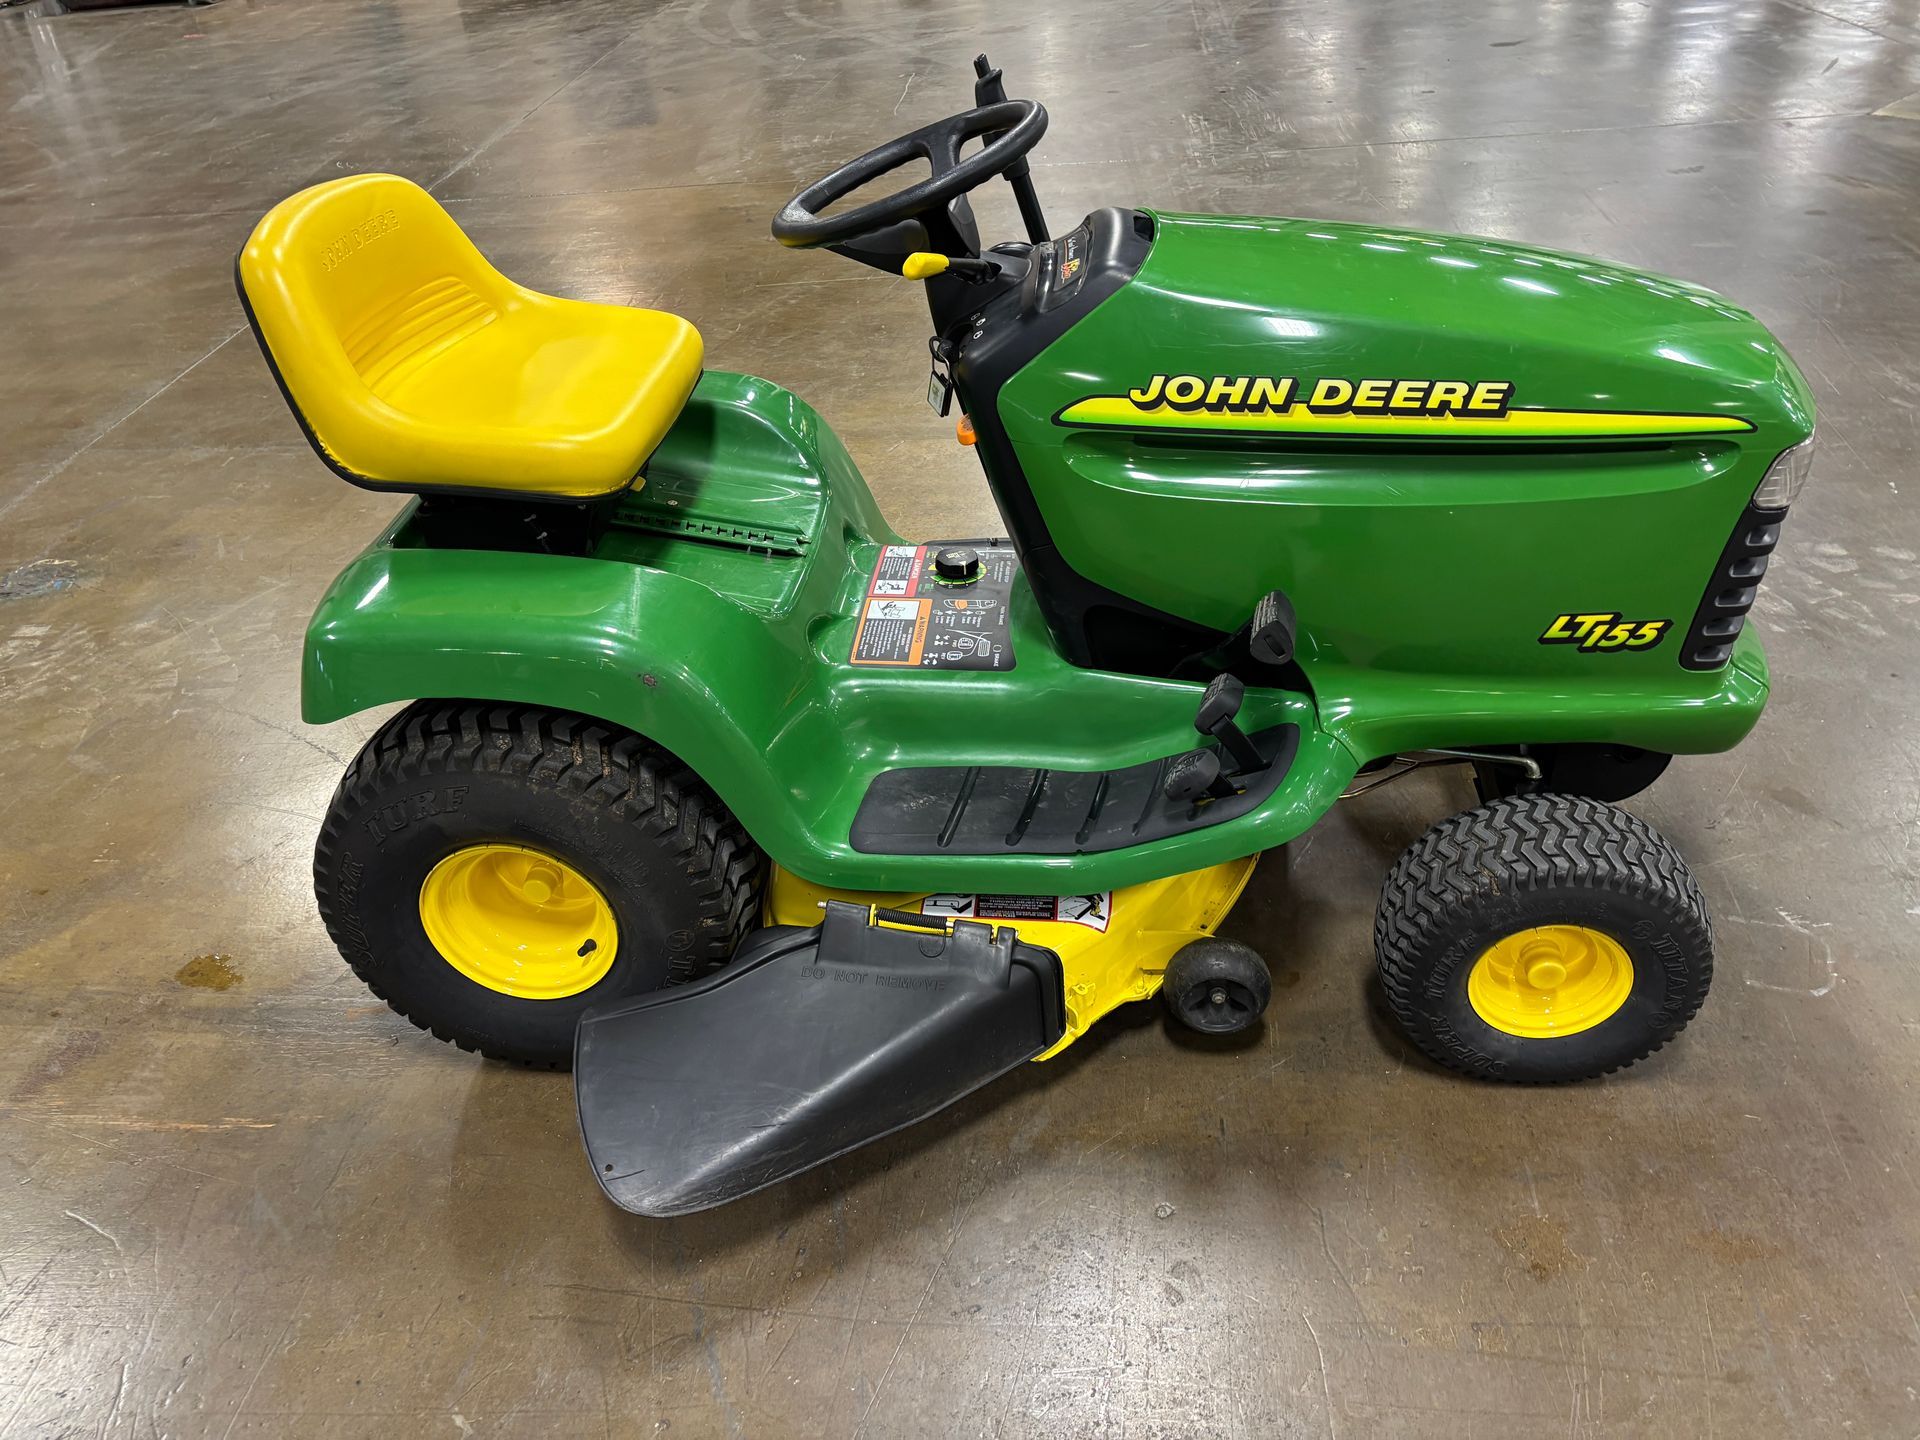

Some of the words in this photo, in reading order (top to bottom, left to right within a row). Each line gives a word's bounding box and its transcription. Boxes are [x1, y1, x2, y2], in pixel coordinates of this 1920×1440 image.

[320, 233, 352, 272] JOHN
[351, 209, 400, 249] DEERE
[1128, 374, 1299, 412] JOHN
[1308, 376, 1516, 416] DEERE
[1540, 613, 1670, 652] LT155
[361, 785, 469, 846] TURF
[338, 851, 378, 967] SUPER
[800, 965, 826, 980] DO
[833, 969, 868, 985] NOT
[875, 974, 945, 991] REMOVE
[1423, 930, 1477, 1001] TURF
[1650, 932, 1690, 1015] TITAN
[1430, 1016, 1510, 1075] SUPER
